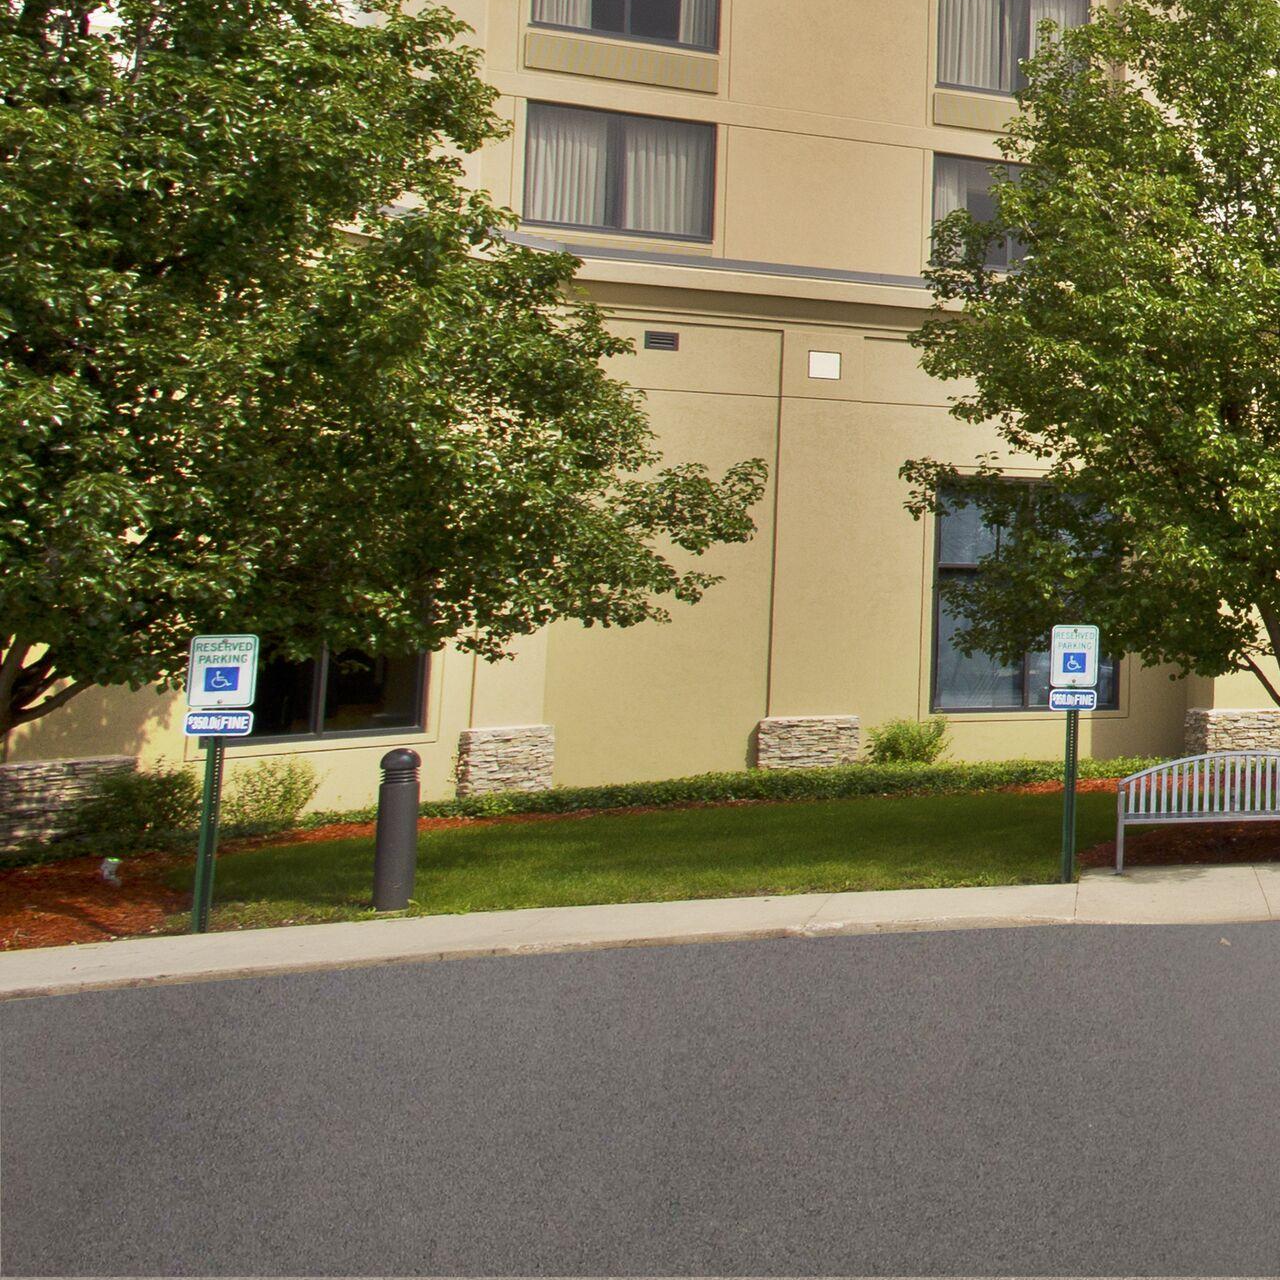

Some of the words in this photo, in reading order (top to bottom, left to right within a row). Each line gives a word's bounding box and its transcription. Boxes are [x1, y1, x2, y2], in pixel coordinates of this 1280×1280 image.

[1056, 632, 1095, 640] RESERVED
[195, 642, 253, 652] RESERVED
[1058, 641, 1092, 650] PARKING
[199, 654, 248, 664] PARKING
[1075, 694, 1094, 706] FINE
[221, 716, 250, 730] FINE
